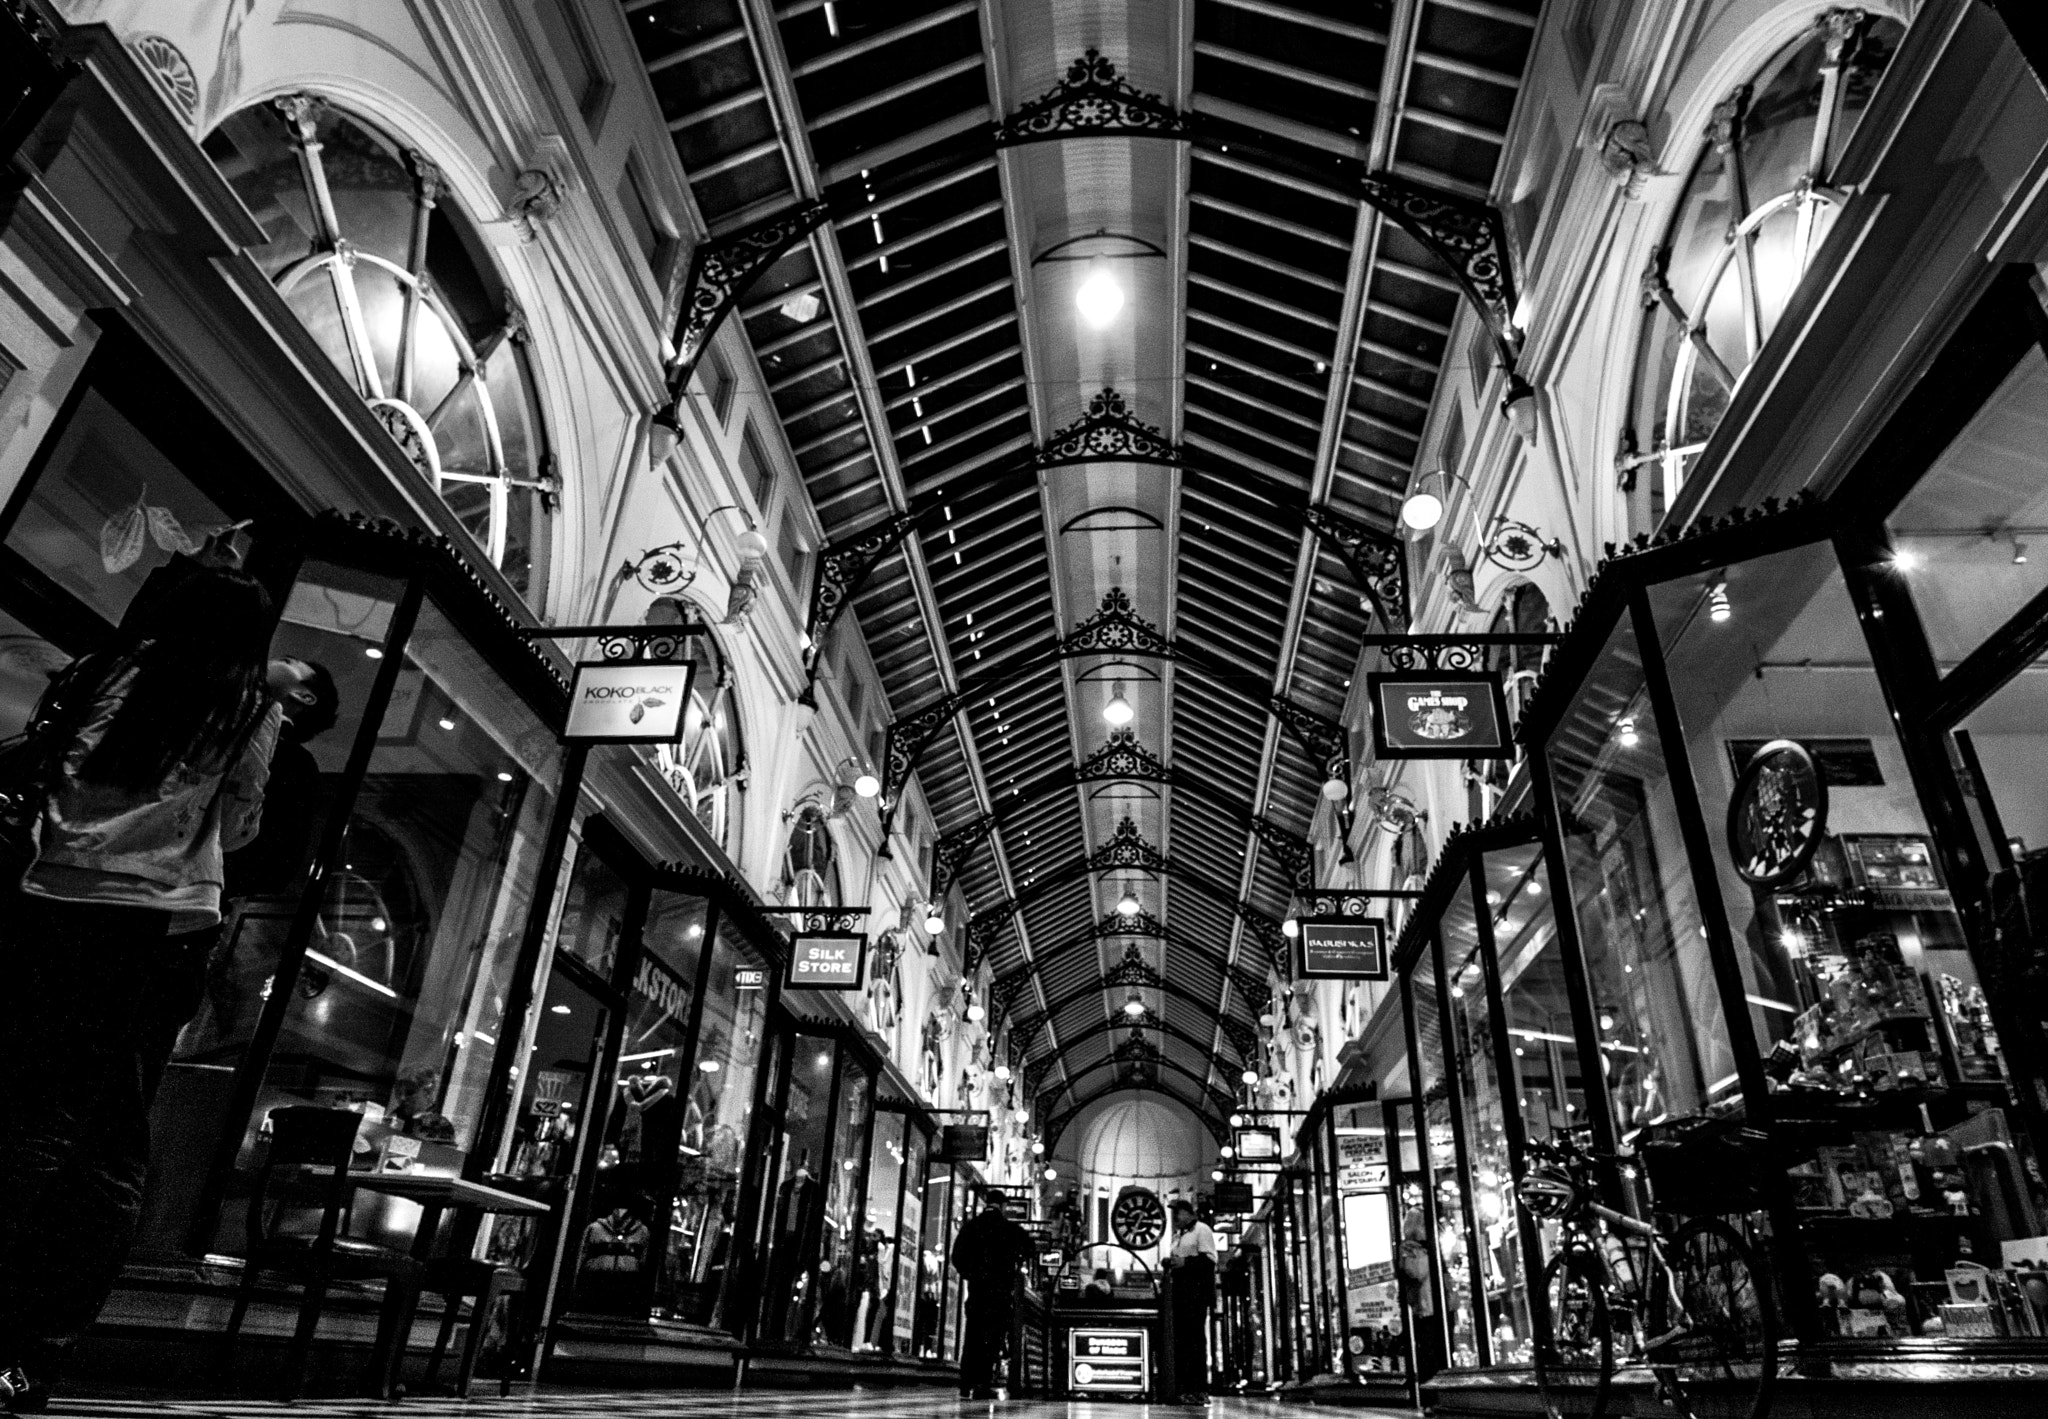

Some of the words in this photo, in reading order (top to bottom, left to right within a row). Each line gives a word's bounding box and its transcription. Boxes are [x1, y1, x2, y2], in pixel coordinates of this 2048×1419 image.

[585, 686, 635, 699] KOKO
[636, 686, 673, 694] BLACK
[1407, 696, 1440, 711] GAMES
[808, 947, 846, 960] SILK
[798, 960, 852, 973] STORE
